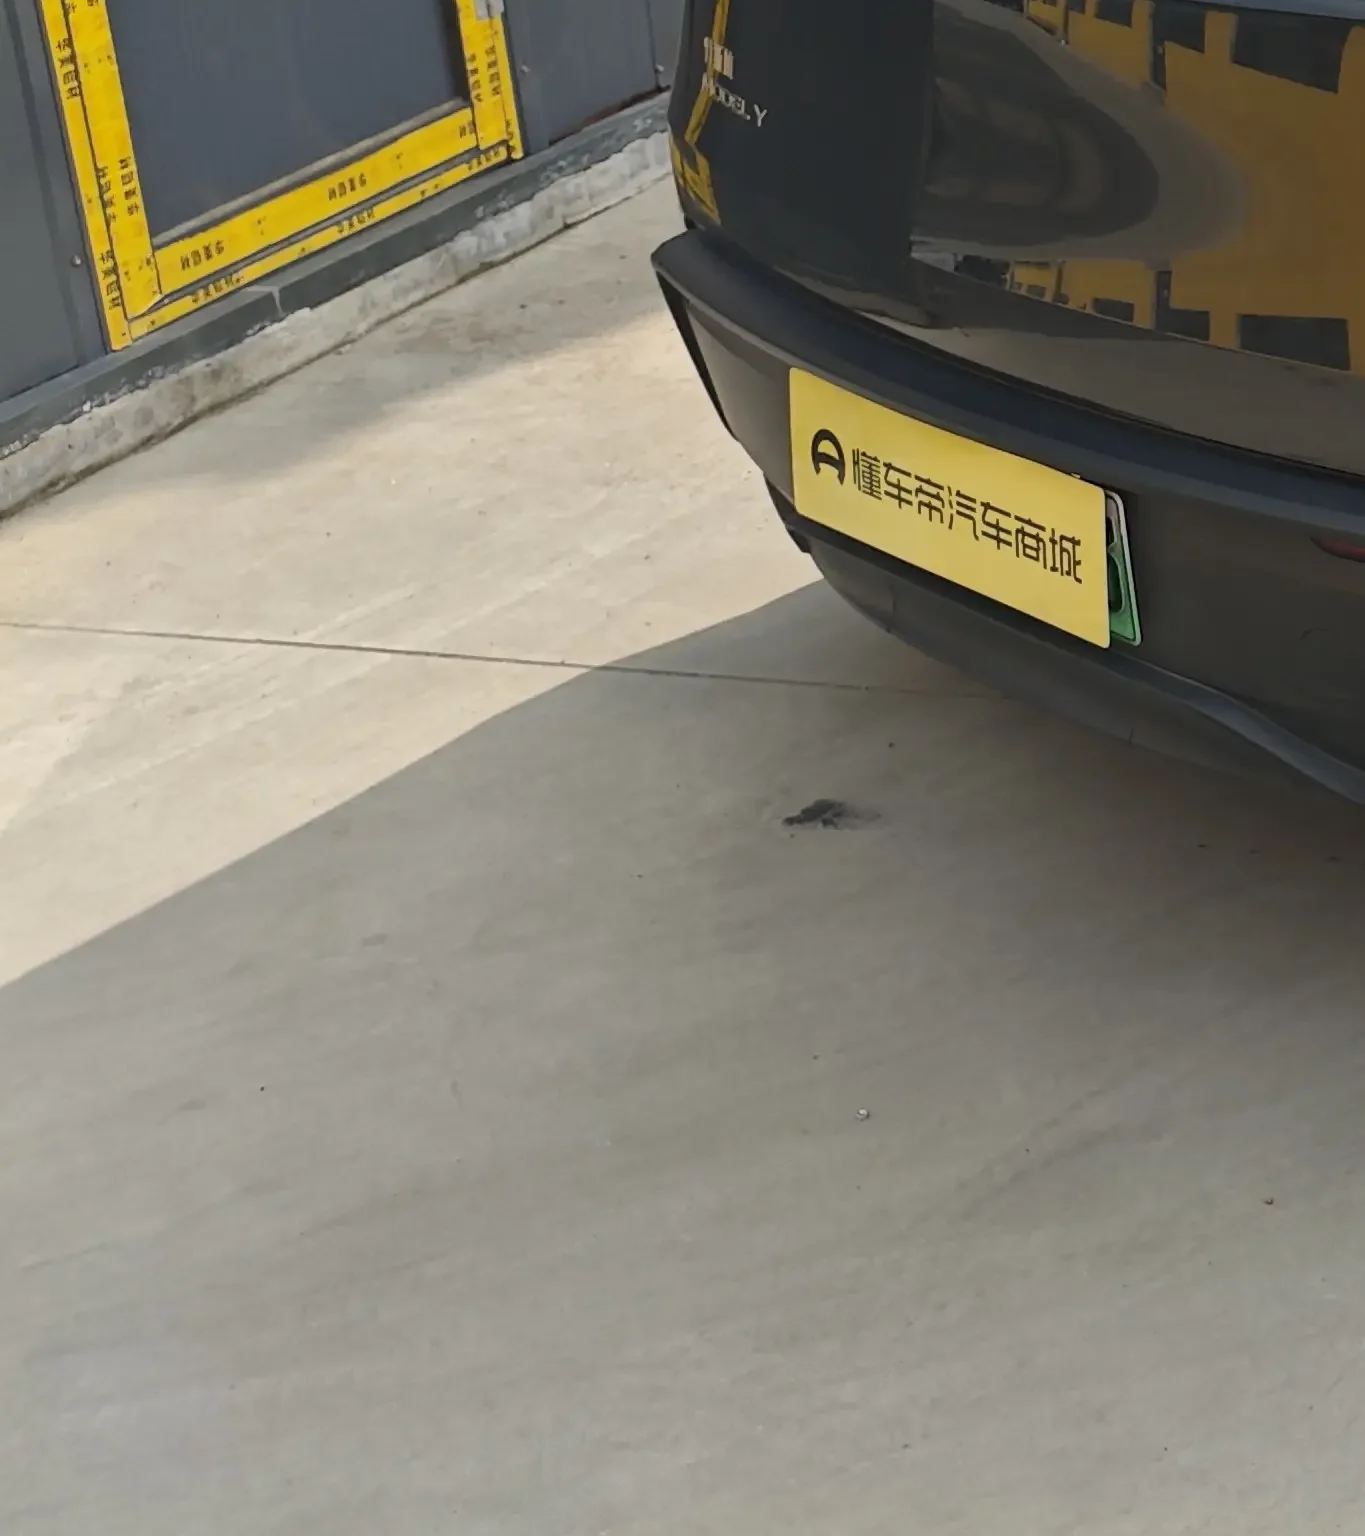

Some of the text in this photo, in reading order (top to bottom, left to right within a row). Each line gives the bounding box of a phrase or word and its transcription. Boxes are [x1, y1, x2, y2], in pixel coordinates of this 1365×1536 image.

[851, 447, 1083, 584] 懂车帝汽车商城
